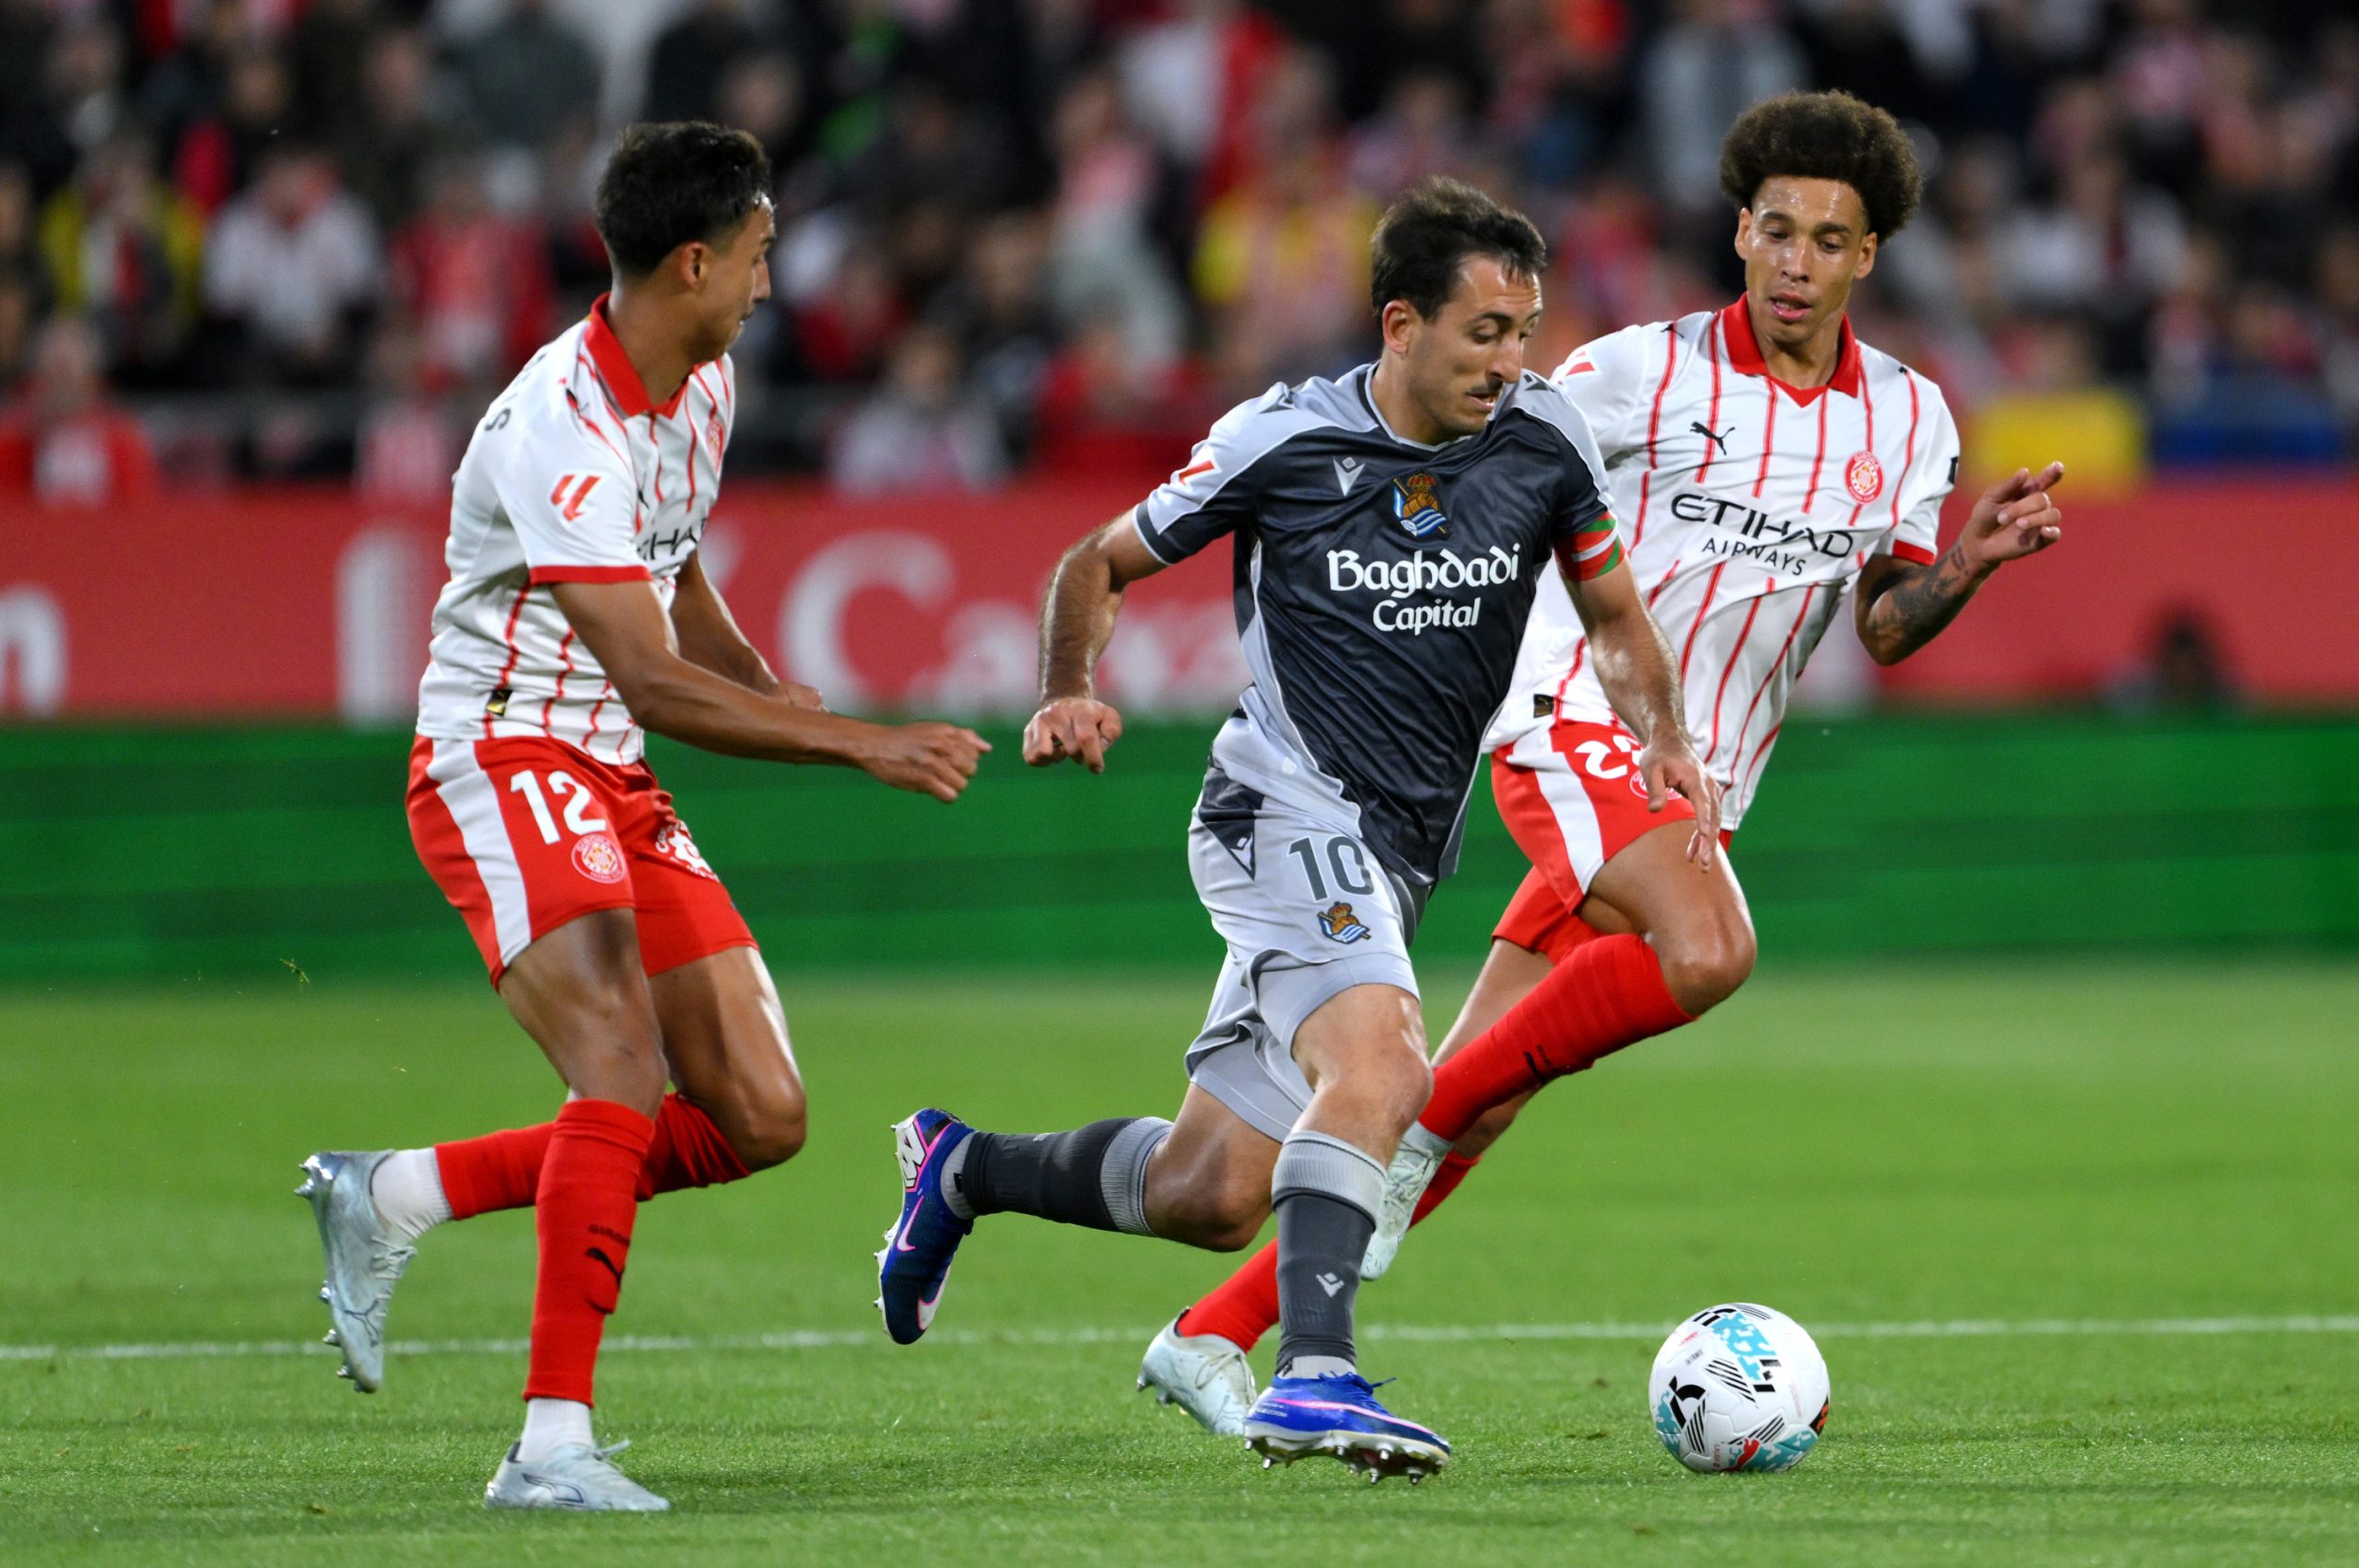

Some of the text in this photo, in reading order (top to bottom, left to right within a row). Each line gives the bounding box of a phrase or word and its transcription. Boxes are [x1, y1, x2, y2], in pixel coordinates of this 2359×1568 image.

[1671, 493, 1853, 557] ETIHAD
[1326, 543, 1520, 598] Baghdadi
[1702, 537, 1806, 576] AIRWAYS
[1373, 597, 1481, 636] Capital
[510, 769, 606, 845] 12
[1287, 835, 1375, 902] 10
